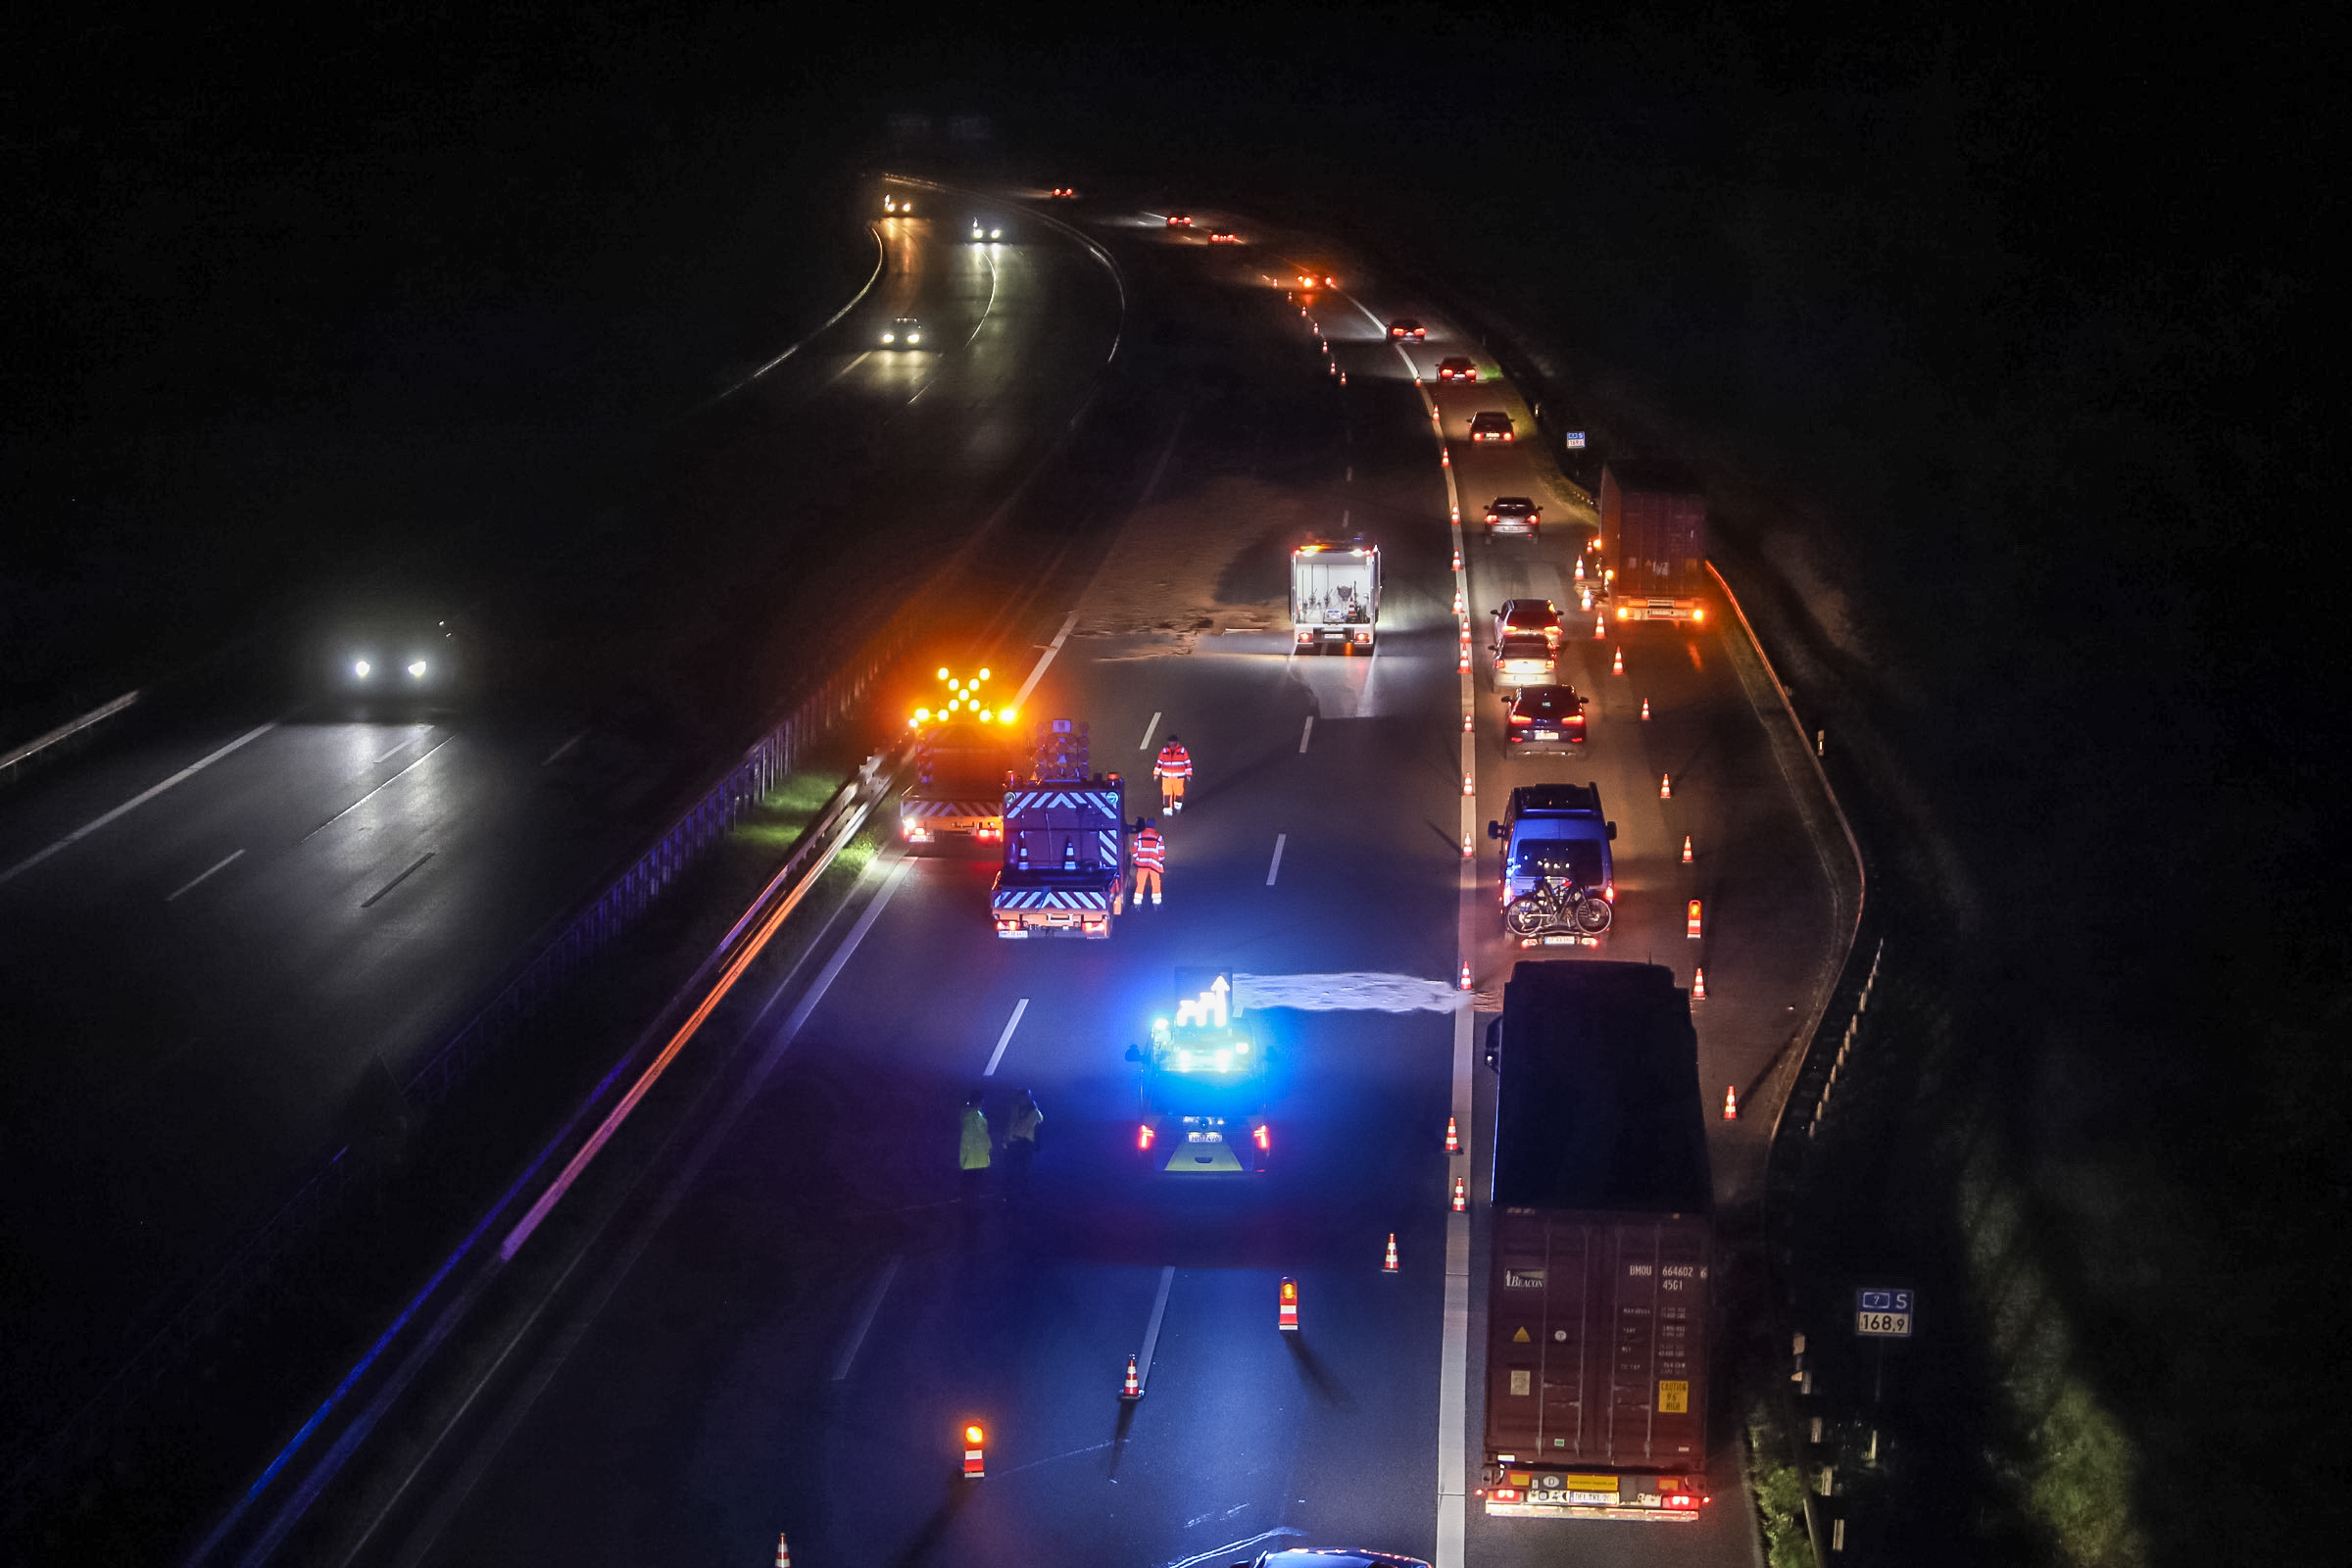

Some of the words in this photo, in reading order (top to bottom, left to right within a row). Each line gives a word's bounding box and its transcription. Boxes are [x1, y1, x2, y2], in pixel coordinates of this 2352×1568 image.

[1630, 1264, 1652, 1276] BMOU
[1662, 1266, 1693, 1278] 664602
[1511, 1275, 1544, 1288] BEACON
[1662, 1280, 1683, 1291] 45G1
[1874, 1296, 1880, 1304] 7
[1895, 1294, 1907, 1309] S
[1863, 1314, 1905, 1332] 168.9
